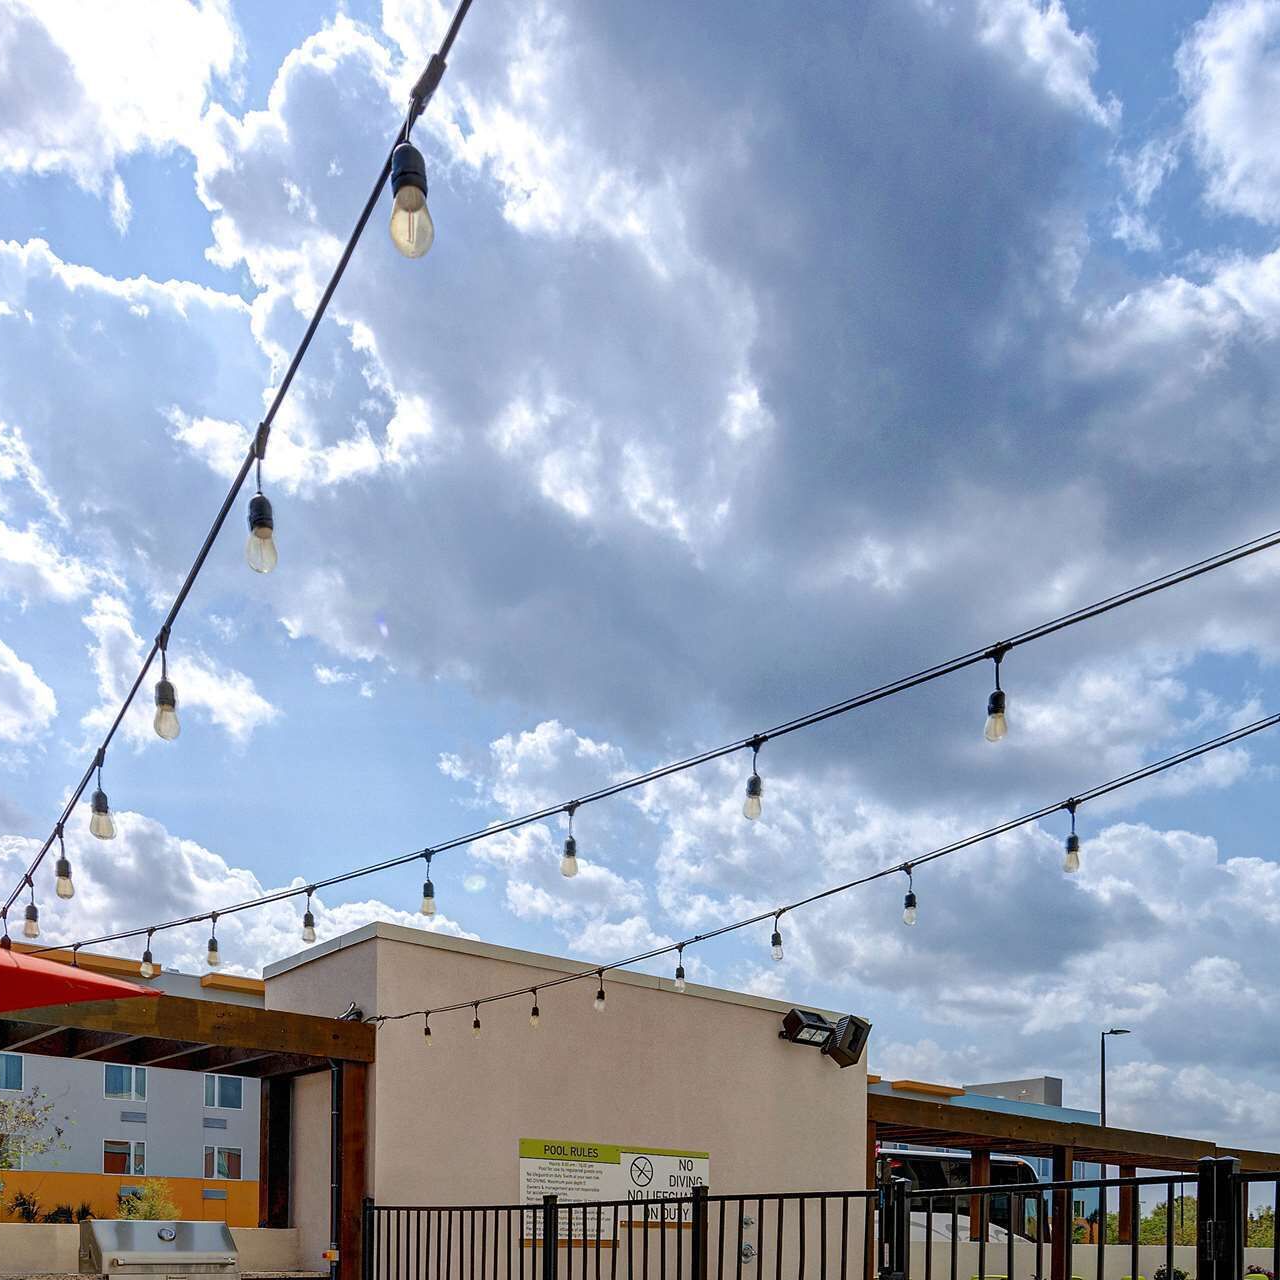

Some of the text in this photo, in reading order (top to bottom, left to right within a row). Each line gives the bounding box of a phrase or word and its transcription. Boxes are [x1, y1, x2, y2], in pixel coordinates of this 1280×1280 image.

[544, 1145, 599, 1158] POOL RULES
[679, 1159, 694, 1172] NO
[669, 1175, 703, 1188] DIVING
[627, 1189, 696, 1204] NO LIFEGUAR
[663, 1207, 690, 1221] DUY
